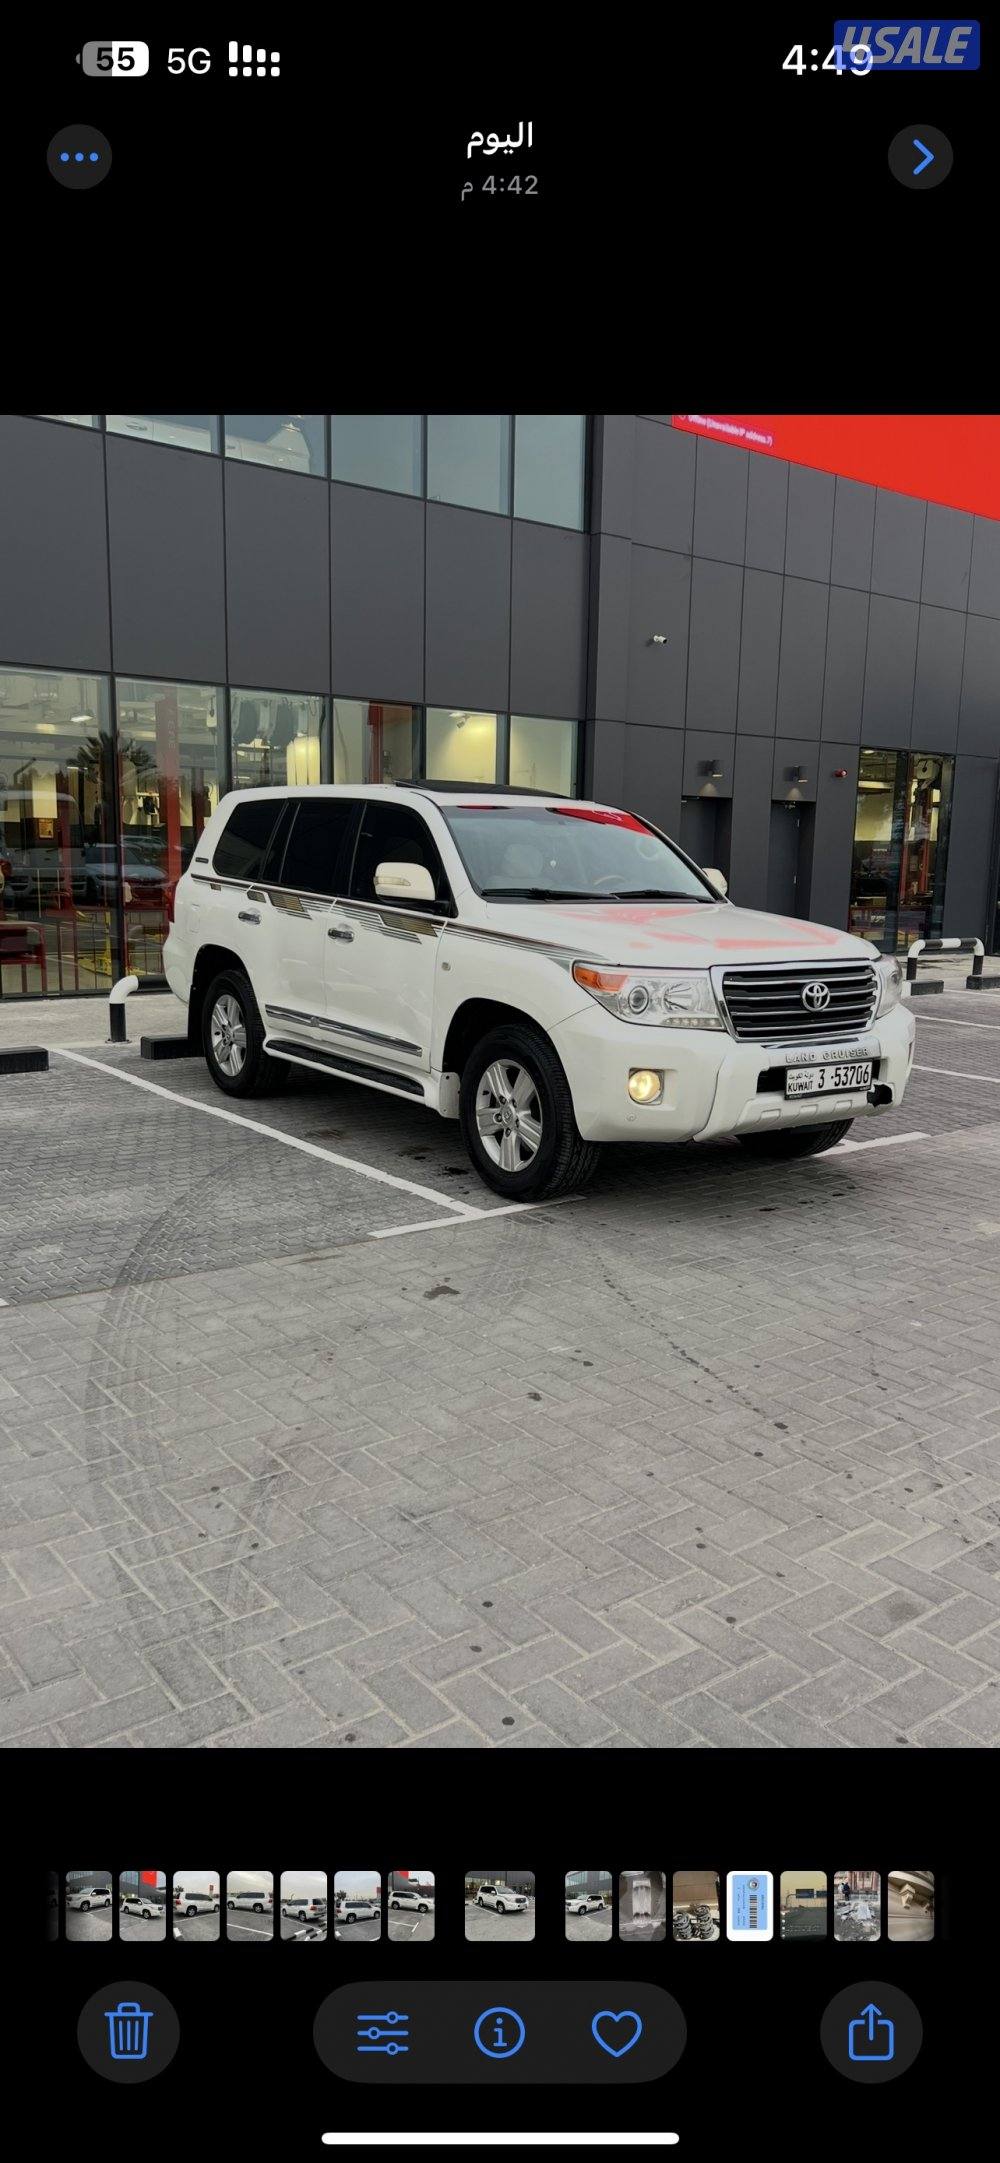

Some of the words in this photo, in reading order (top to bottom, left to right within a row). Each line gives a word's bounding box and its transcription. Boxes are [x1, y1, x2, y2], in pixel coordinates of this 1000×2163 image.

[785, 1052, 817, 1063] LAND
[822, 1047, 869, 1060] CRUISER
[787, 1080, 813, 1093] KUWAIT
[818, 1068, 826, 1089] 3
